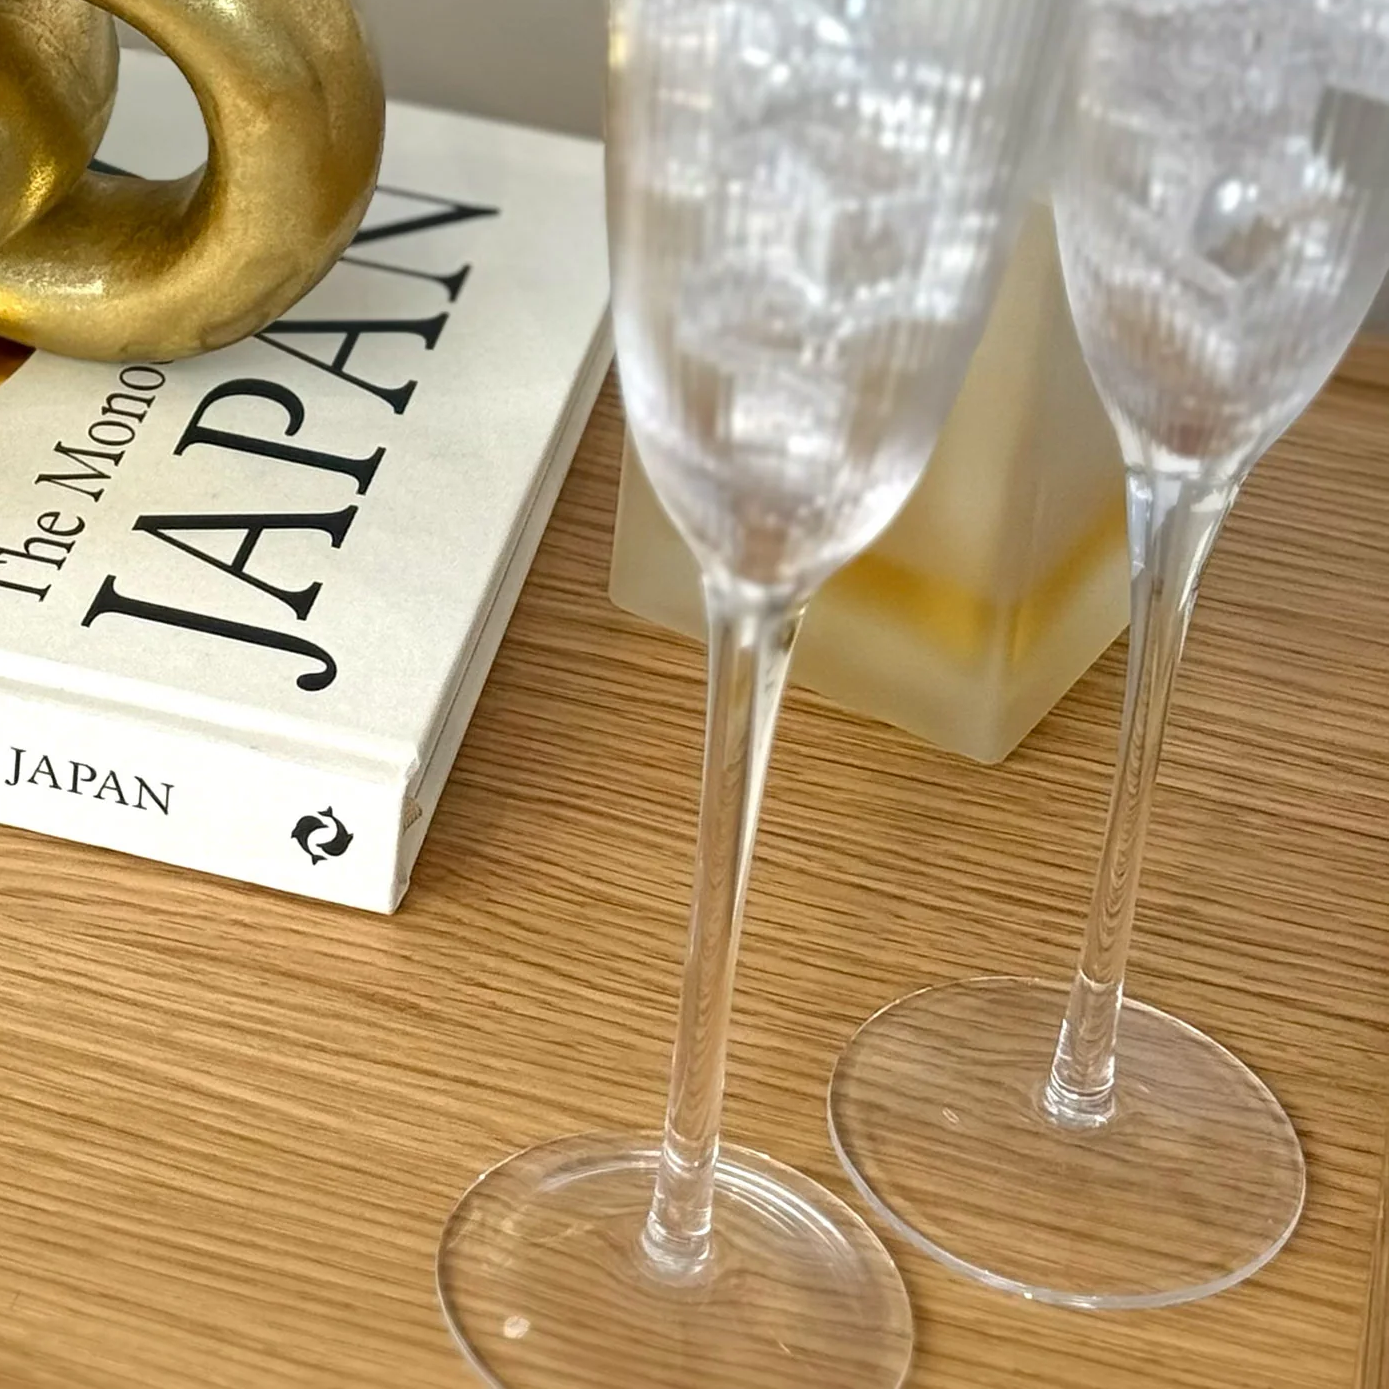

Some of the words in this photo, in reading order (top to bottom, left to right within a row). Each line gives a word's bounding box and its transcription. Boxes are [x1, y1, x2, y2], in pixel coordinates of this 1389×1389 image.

[34, 359, 175, 503] Mono
[80, 183, 501, 692] JAPAN
[4, 746, 176, 817] JAPAN
